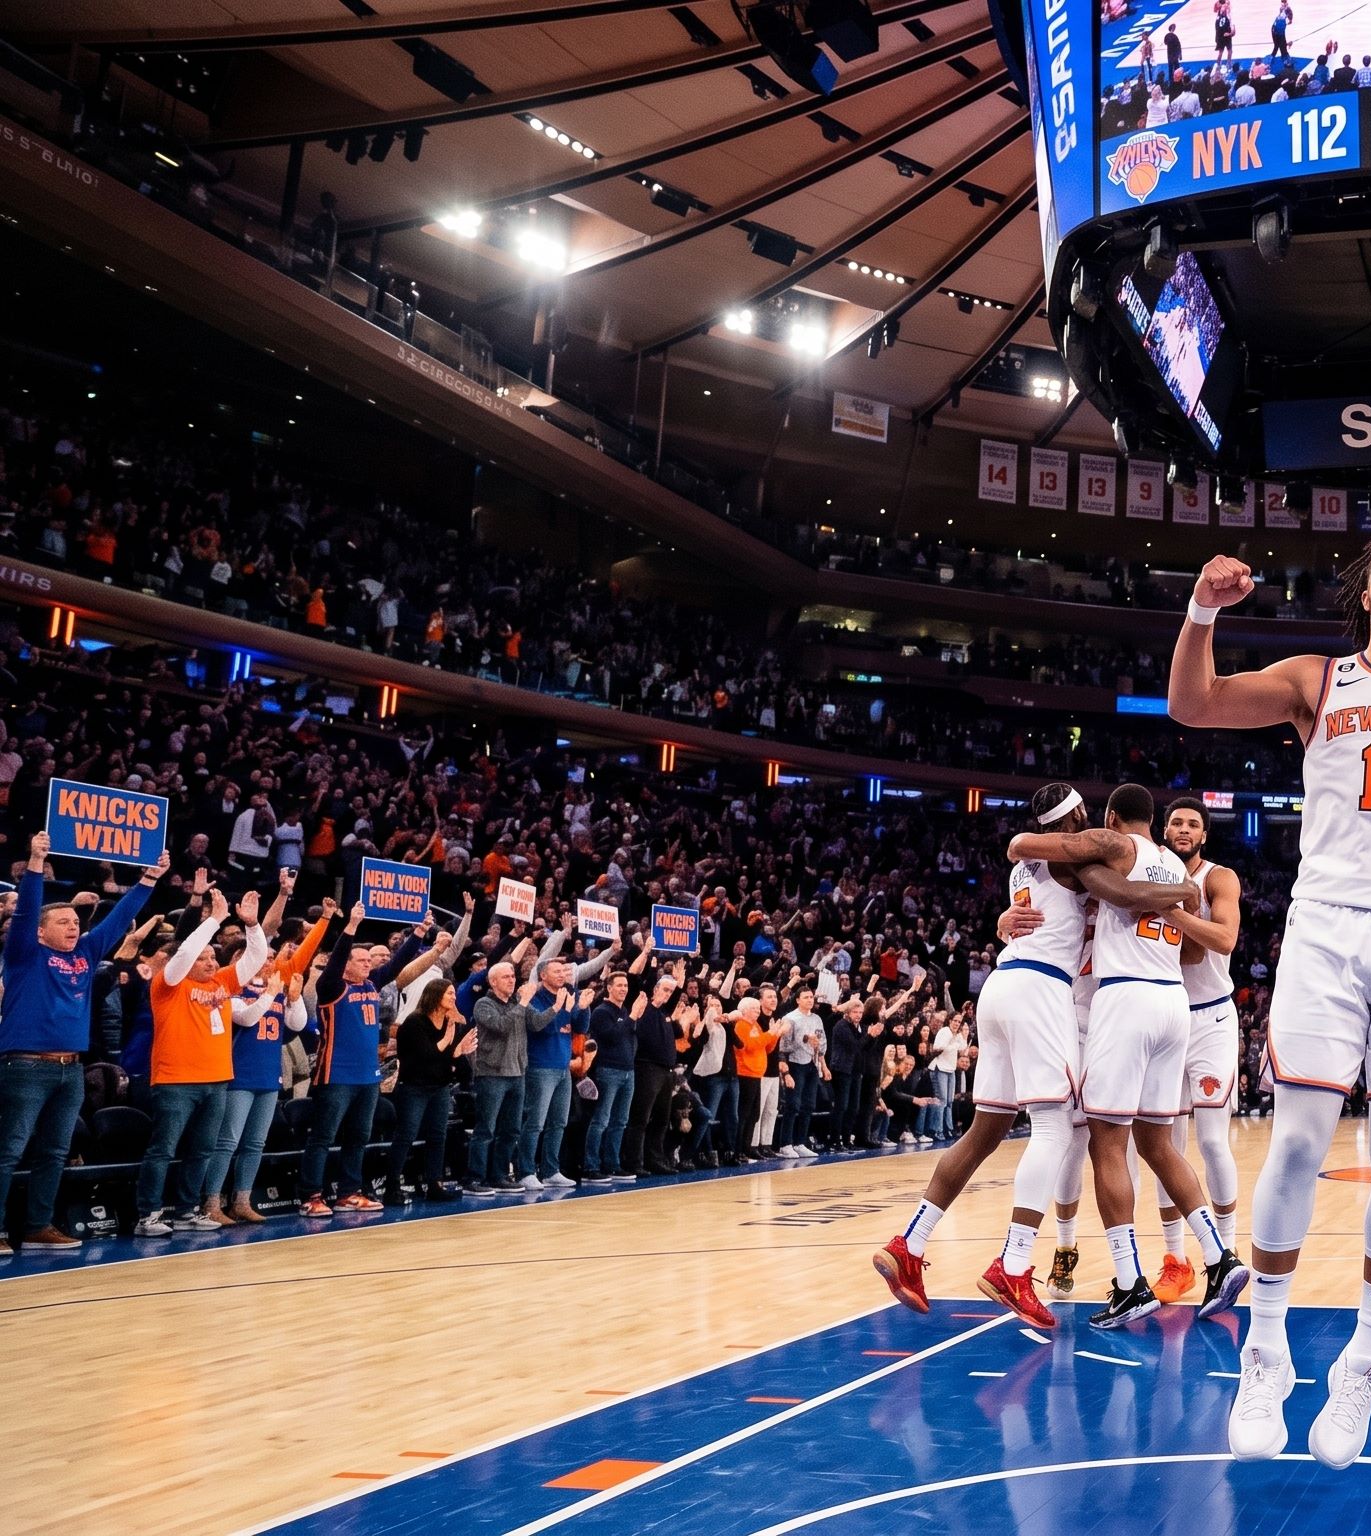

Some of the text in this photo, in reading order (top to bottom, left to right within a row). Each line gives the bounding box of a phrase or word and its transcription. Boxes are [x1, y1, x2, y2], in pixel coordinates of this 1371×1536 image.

[1192, 104, 1347, 180] NYK 112
[987, 463, 1008, 485] 14
[1038, 470, 1058, 491] 13
[1087, 477, 1107, 498] 13
[1139, 482, 1153, 501] 9
[1319, 495, 1341, 515] 10
[58, 788, 160, 831] KNICKS
[75, 822, 141, 858] WIN!
[364, 869, 395, 890] NEW
[368, 889, 423, 913] FOREVER
